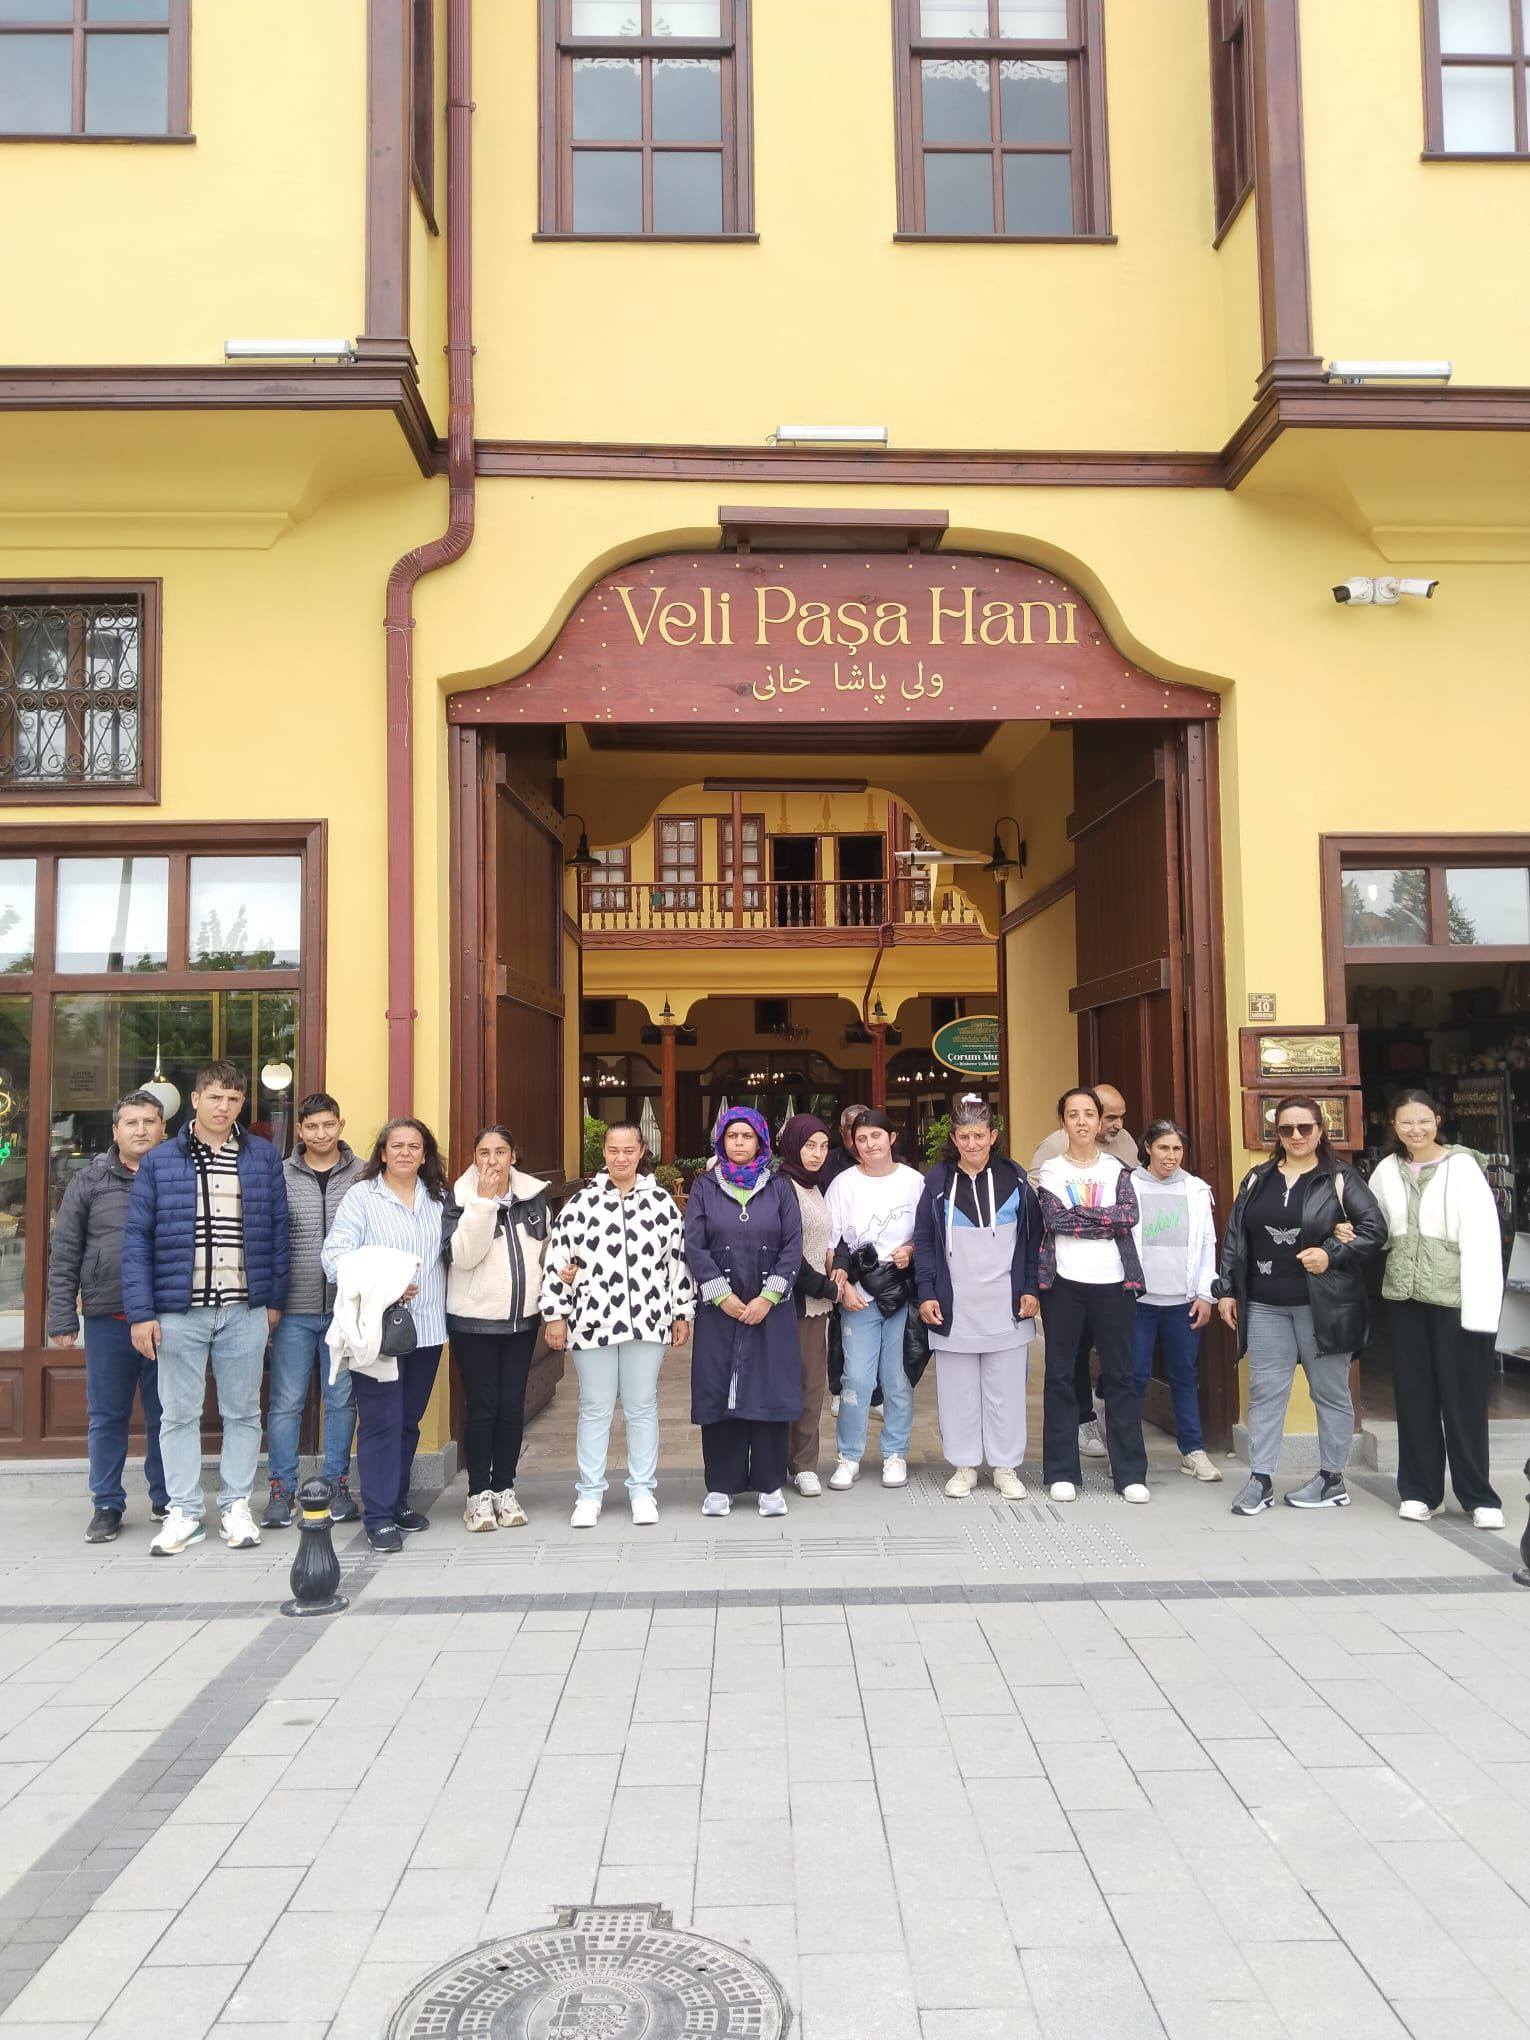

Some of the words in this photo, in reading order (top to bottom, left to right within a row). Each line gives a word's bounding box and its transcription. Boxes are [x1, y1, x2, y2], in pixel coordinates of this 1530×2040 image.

[615, 587, 734, 646] Veli
[753, 587, 911, 656] Paşa
[928, 587, 1079, 645] Hanı
[1256, 1002, 1270, 1011] 10
[947, 1053, 981, 1062] Çorum
[983, 1053, 998, 1061] Mu
